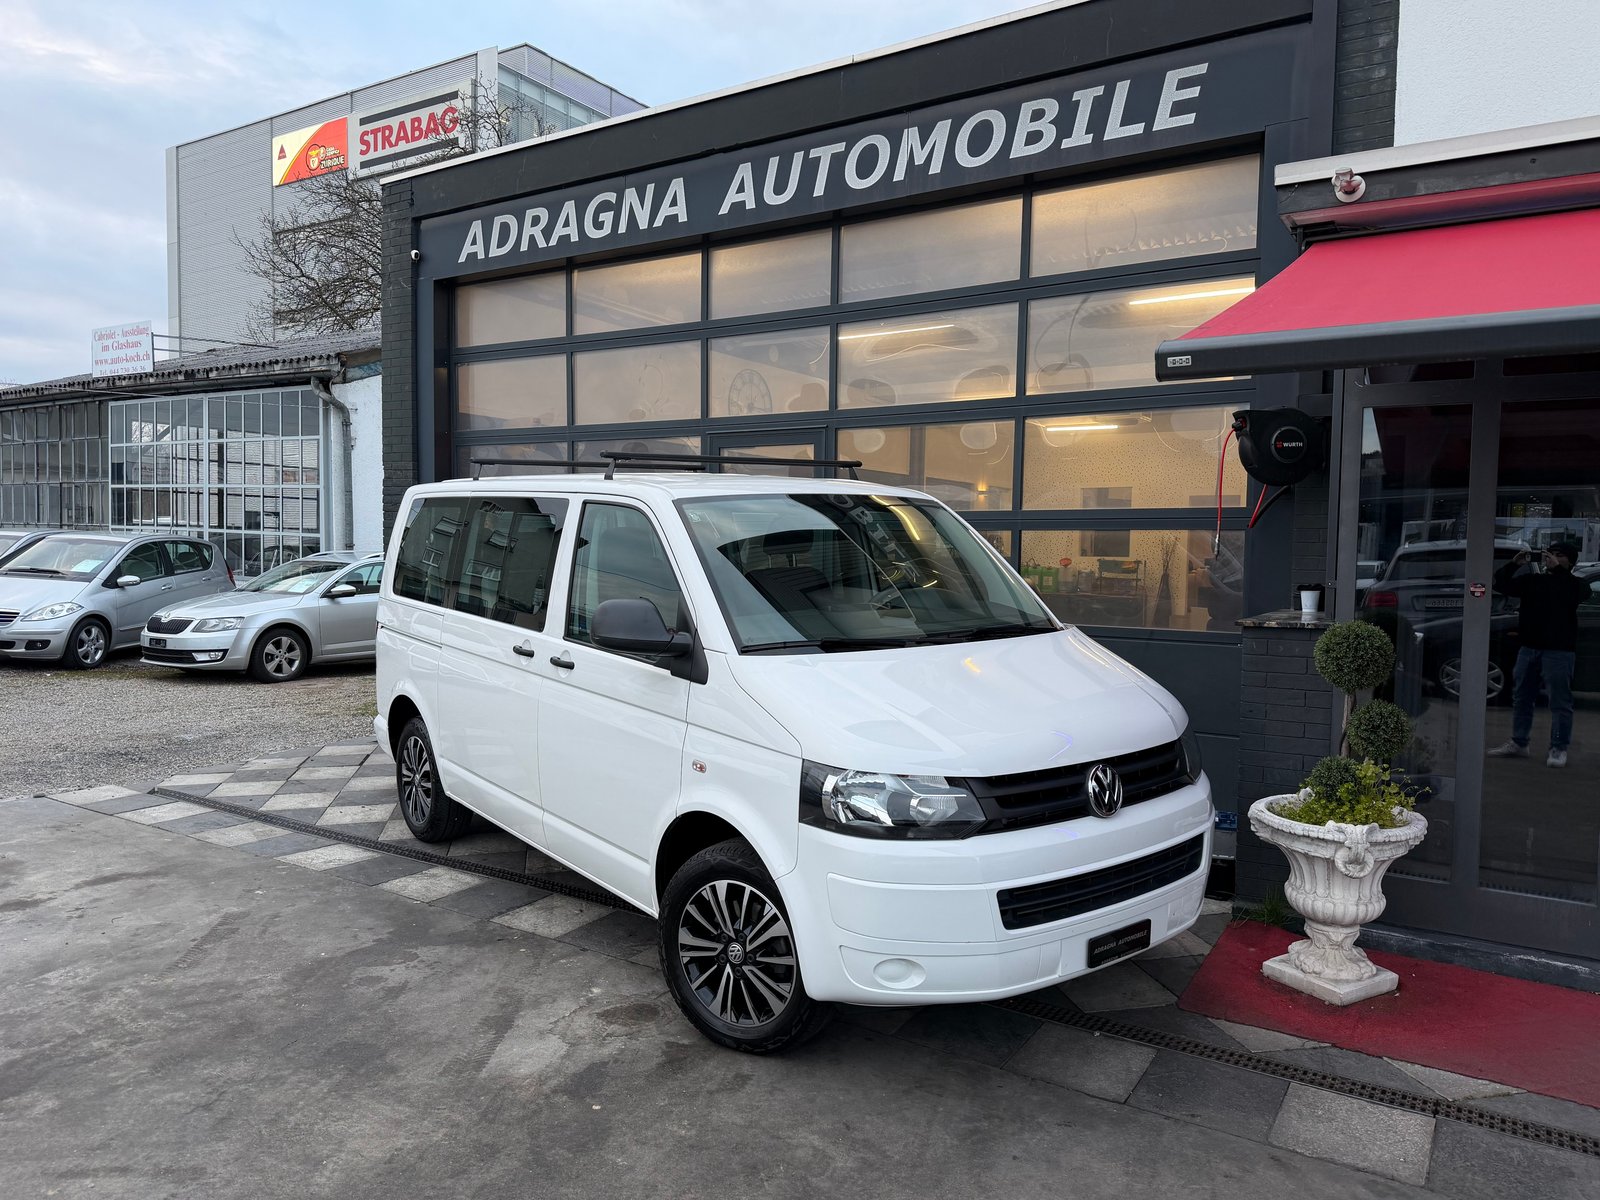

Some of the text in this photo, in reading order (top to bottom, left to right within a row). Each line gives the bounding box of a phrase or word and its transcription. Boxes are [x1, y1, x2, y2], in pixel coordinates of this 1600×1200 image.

[359, 105, 459, 156] STRABAG
[458, 62, 1208, 264] ADRAGNA AUTOMOBILE
[95, 350, 151, 366] www.auto-koch.ch
[101, 339, 142, 352] im Glashaus
